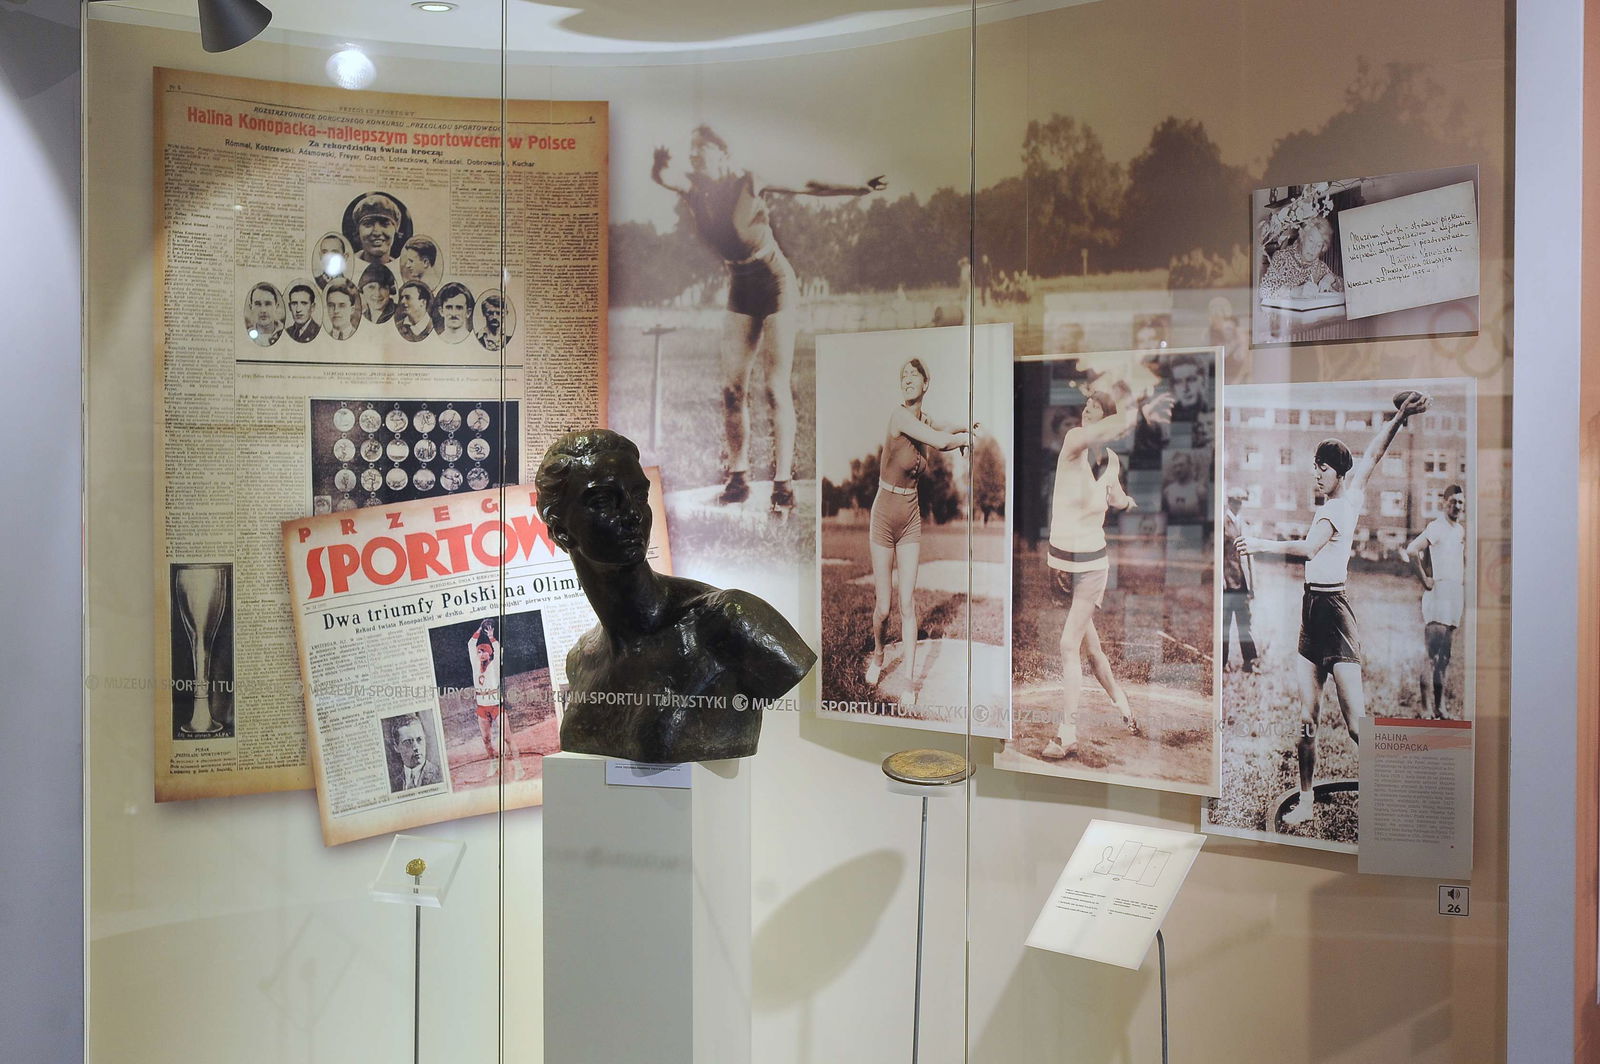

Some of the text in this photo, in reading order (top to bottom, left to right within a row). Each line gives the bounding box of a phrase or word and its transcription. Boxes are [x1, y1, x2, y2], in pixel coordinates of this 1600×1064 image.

[187, 106, 233, 127] Halina
[413, 132, 502, 149] sportowcem
[507, 136, 523, 149] w
[528, 135, 577, 152] Polsce
[308, 139, 443, 157] Za rekordzistką świata kroczą:
[512, 160, 536, 168] Kuchar
[323, 613, 361, 631] Dwa
[367, 597, 435, 625] triumfy
[442, 585, 497, 609] Polski
[505, 585, 526, 598] na
[355, 624, 378, 634] Rekord
[526, 596, 552, 606] pierwszy
[368, 685, 421, 700] SPORTU
[589, 691, 643, 707] SPORTU
[645, 694, 650, 707] I
[652, 694, 728, 710] TURYSTYKI
[820, 699, 878, 716] SPORTU
[880, 702, 886, 716] I
[1375, 733, 1408, 742] HALINA
[1375, 742, 1429, 752] KONOPACKA
[1447, 903, 1461, 914] 26
